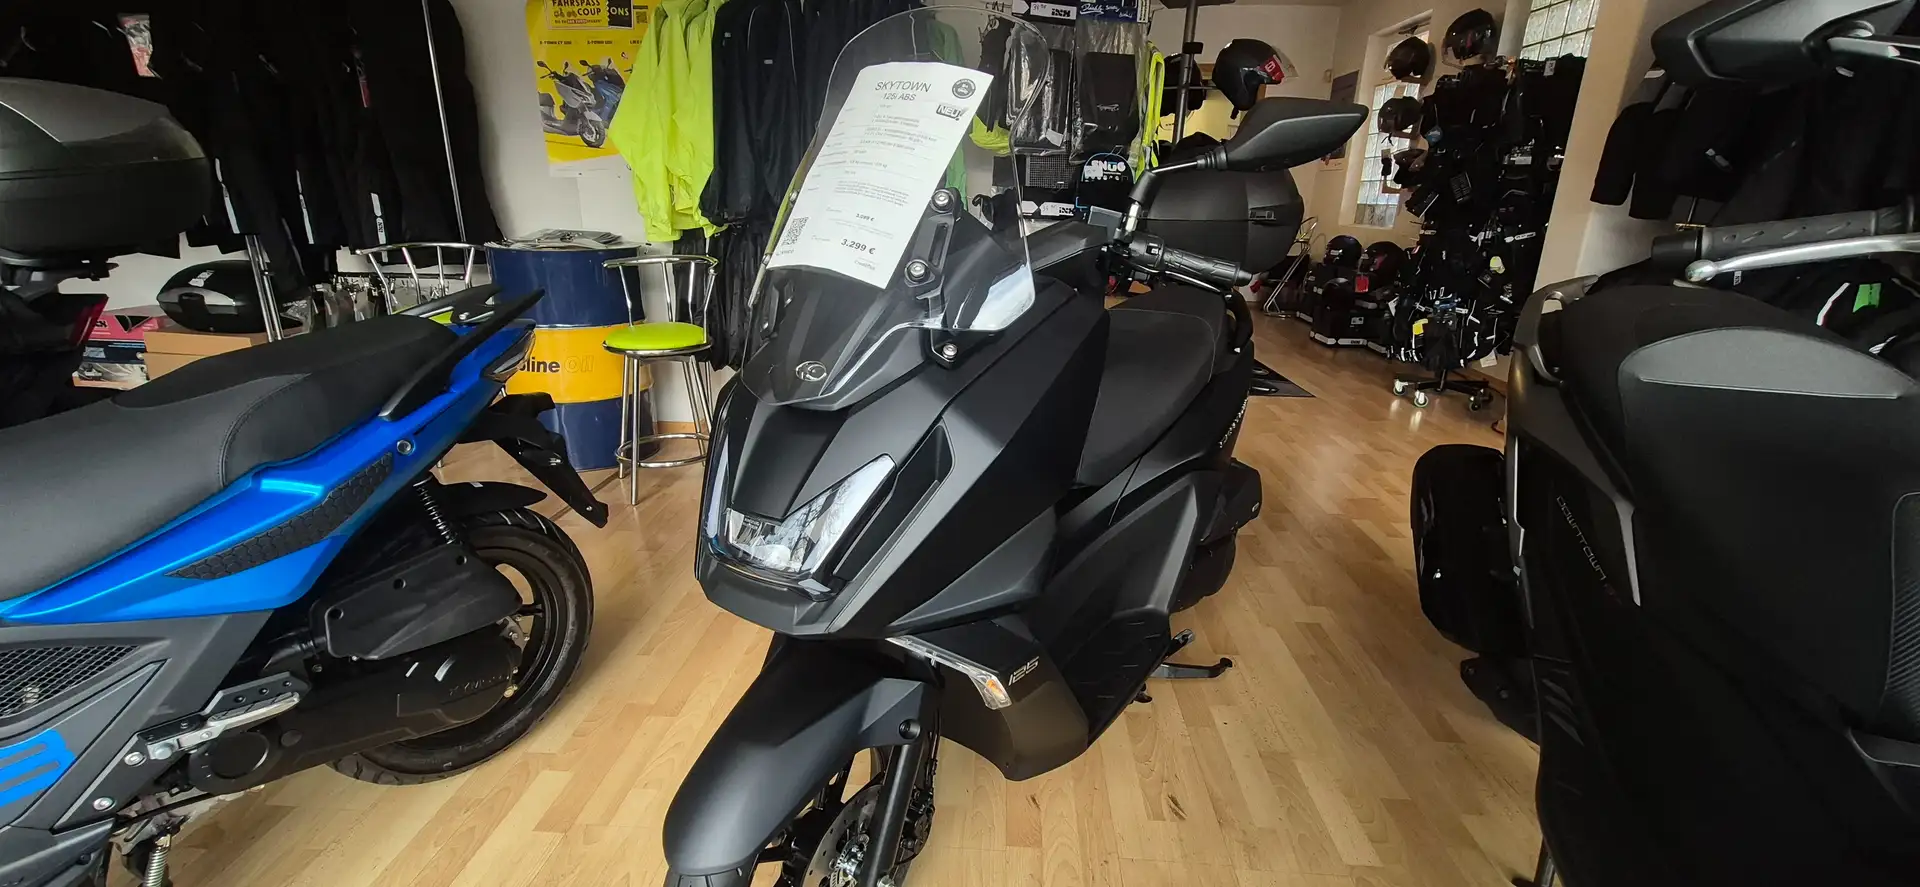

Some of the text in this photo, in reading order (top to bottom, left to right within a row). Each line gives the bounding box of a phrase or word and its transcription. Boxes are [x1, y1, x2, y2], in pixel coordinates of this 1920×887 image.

[577, 6, 629, 16] COUP ONS
[875, 80, 932, 93] SKYTOWN
[898, 93, 917, 101] ABS
[840, 238, 867, 252] 3.299
[868, 247, 876, 255] €
[1008, 655, 1040, 686] 125
